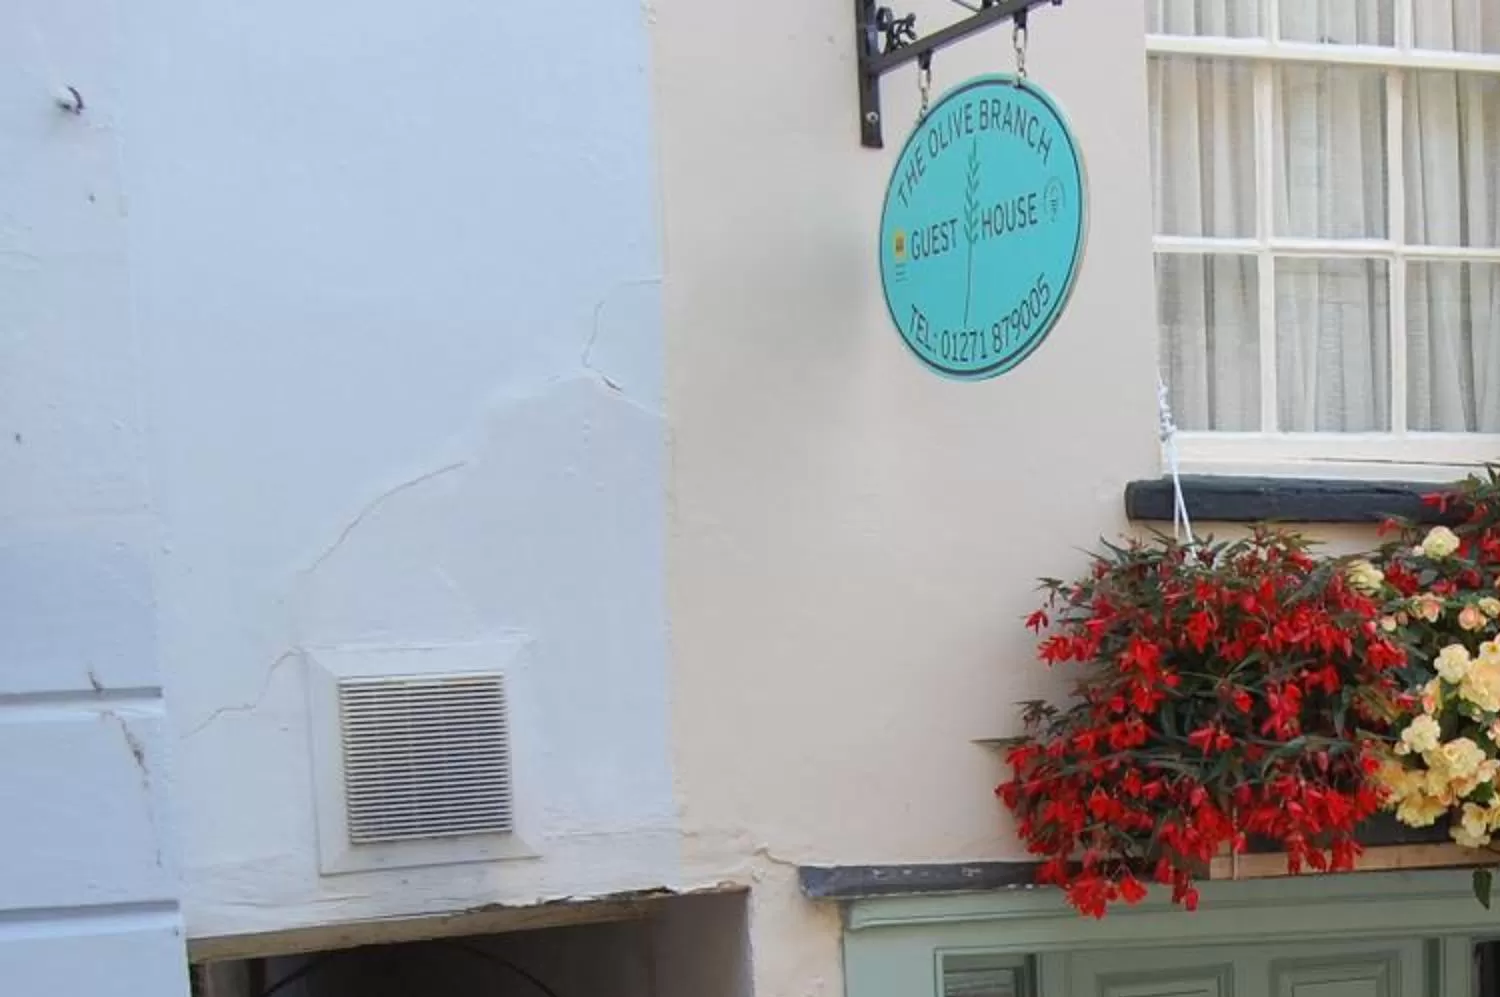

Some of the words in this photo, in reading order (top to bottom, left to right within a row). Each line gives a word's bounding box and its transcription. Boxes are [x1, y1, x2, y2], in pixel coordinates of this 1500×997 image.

[898, 146, 927, 207] THE
[928, 103, 973, 158] OLIVE
[979, 99, 1053, 164] BRANCH
[911, 219, 958, 260] GUEST
[981, 193, 1038, 240] HOUSE
[941, 330, 988, 362] 01271
[991, 272, 1050, 353] 879005
